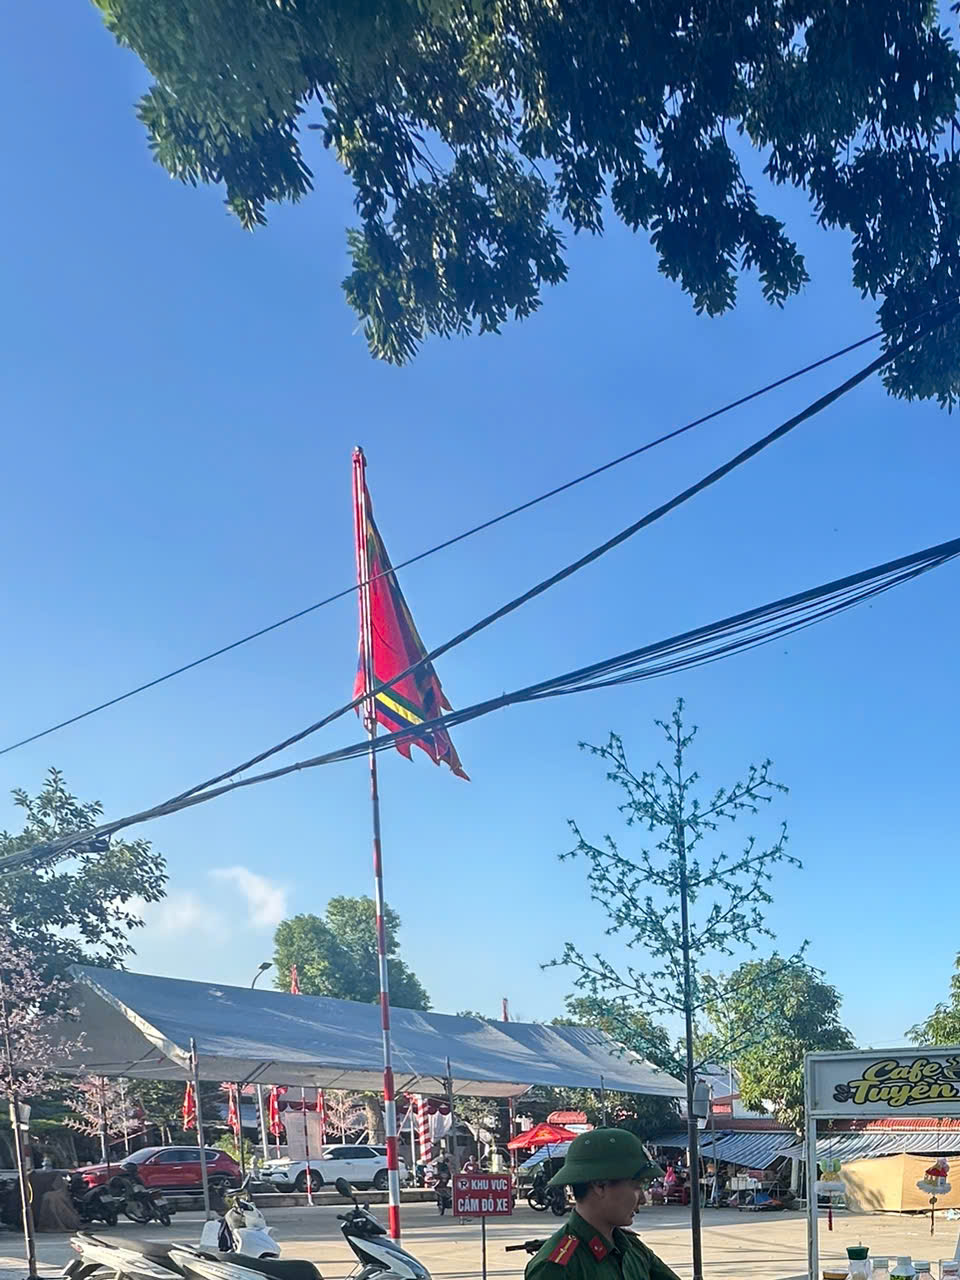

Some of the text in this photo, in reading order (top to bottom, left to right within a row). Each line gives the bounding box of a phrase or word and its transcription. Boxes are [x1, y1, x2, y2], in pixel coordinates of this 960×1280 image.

[862, 1057, 943, 1082] Cafe
[471, 1178, 508, 1192] KHU VỰC
[457, 1193, 508, 1212] CẤM ĐỖ XE
